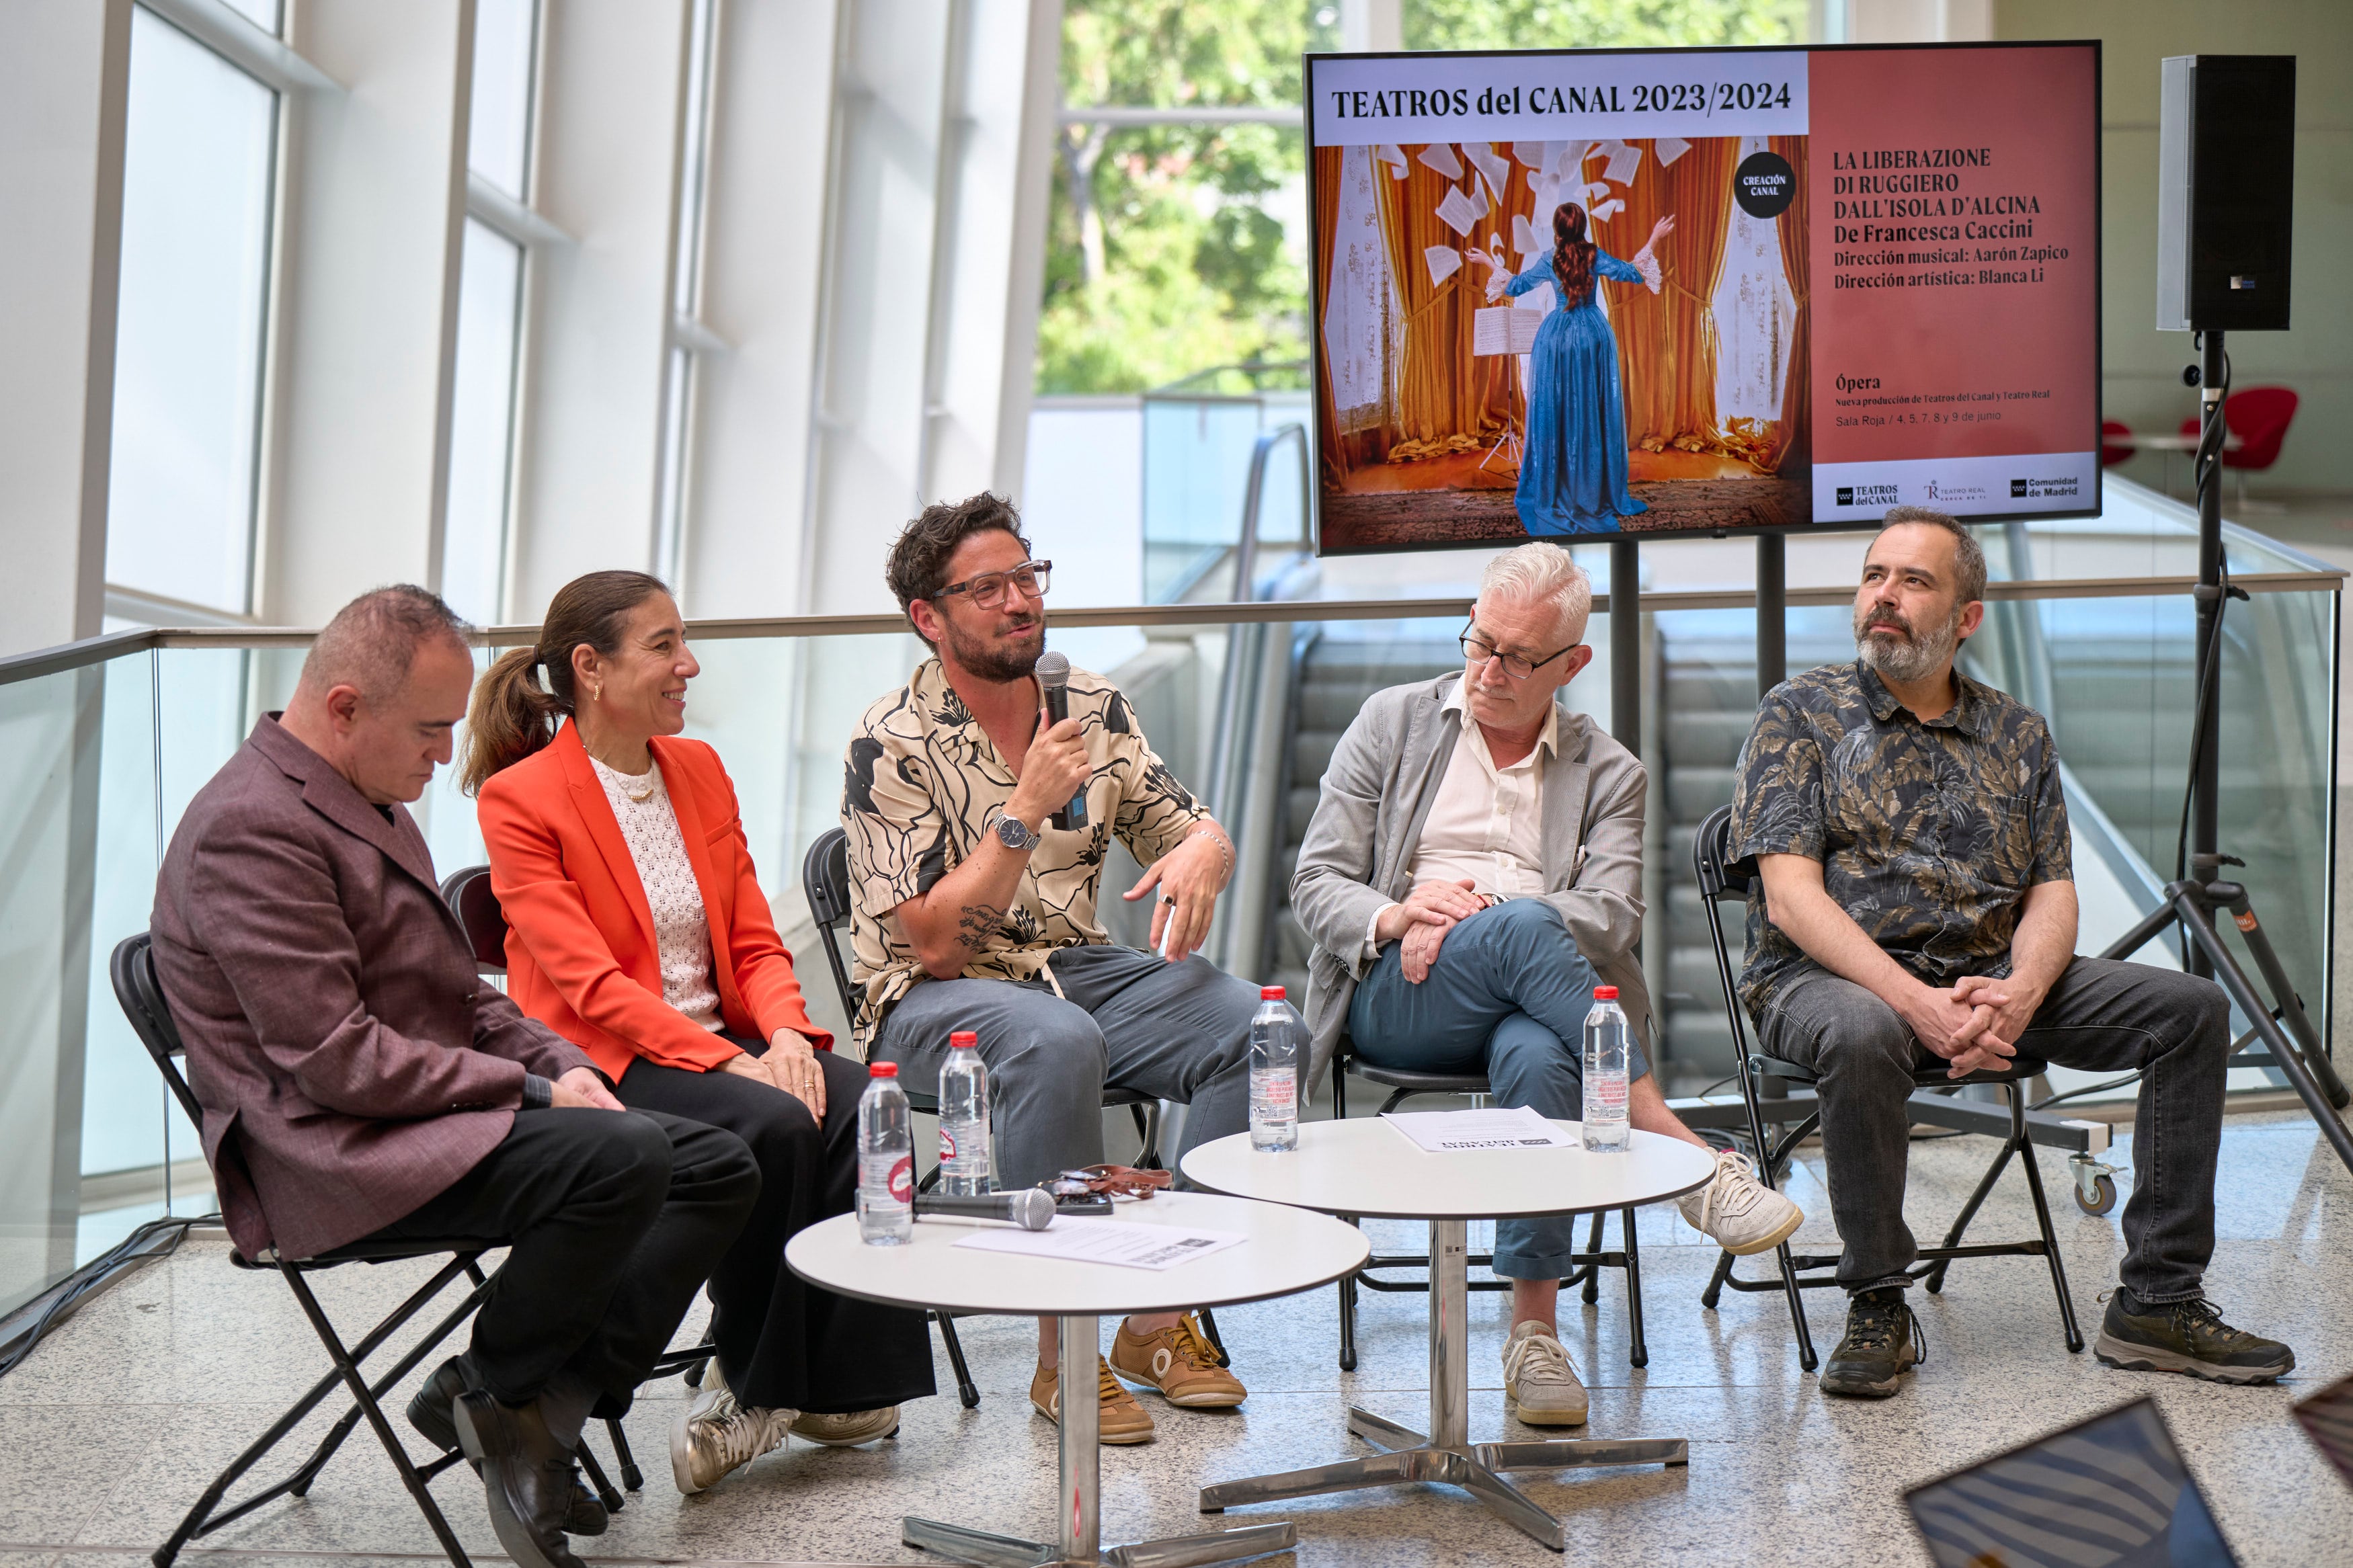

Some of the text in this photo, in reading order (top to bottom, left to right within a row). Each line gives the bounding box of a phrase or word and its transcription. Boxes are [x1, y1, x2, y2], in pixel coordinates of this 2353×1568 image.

[1331, 82, 1791, 118] TEATROS del CANAL 2023/2024
[1833, 149, 1991, 170] LA LIBERAZIONE
[1743, 174, 1786, 185] CREACIÓN
[1833, 173, 1959, 194] DI RUGGIERO
[1751, 187, 1779, 196] CANAL
[1833, 196, 2040, 219] DALL'ISOLA D'ALCINA
[1834, 219, 2033, 243] De Francesca Caccini
[1834, 245, 2069, 267] Dirección musical: Aarón Zapico
[1835, 267, 2043, 289] Dirección artística: Blanca Li
[1835, 373, 1880, 393] Ópera
[1835, 390, 2050, 408] Nueva producción de Teatros del Canal y Teatro Real
[1836, 416, 1858, 427] Sala
[1862, 415, 1885, 427] Roja
[1888, 414, 1892, 425] /
[1933, 413, 1940, 423] 8
[1943, 415, 1948, 424] y
[1952, 413, 1958, 422] 9
[1962, 411, 1974, 421] de
[1977, 411, 2001, 423] junio
[1856, 485, 1898, 495] TEATROS
[2028, 477, 2077, 486] Comunidad
[2029, 486, 2077, 497] de Madrid
